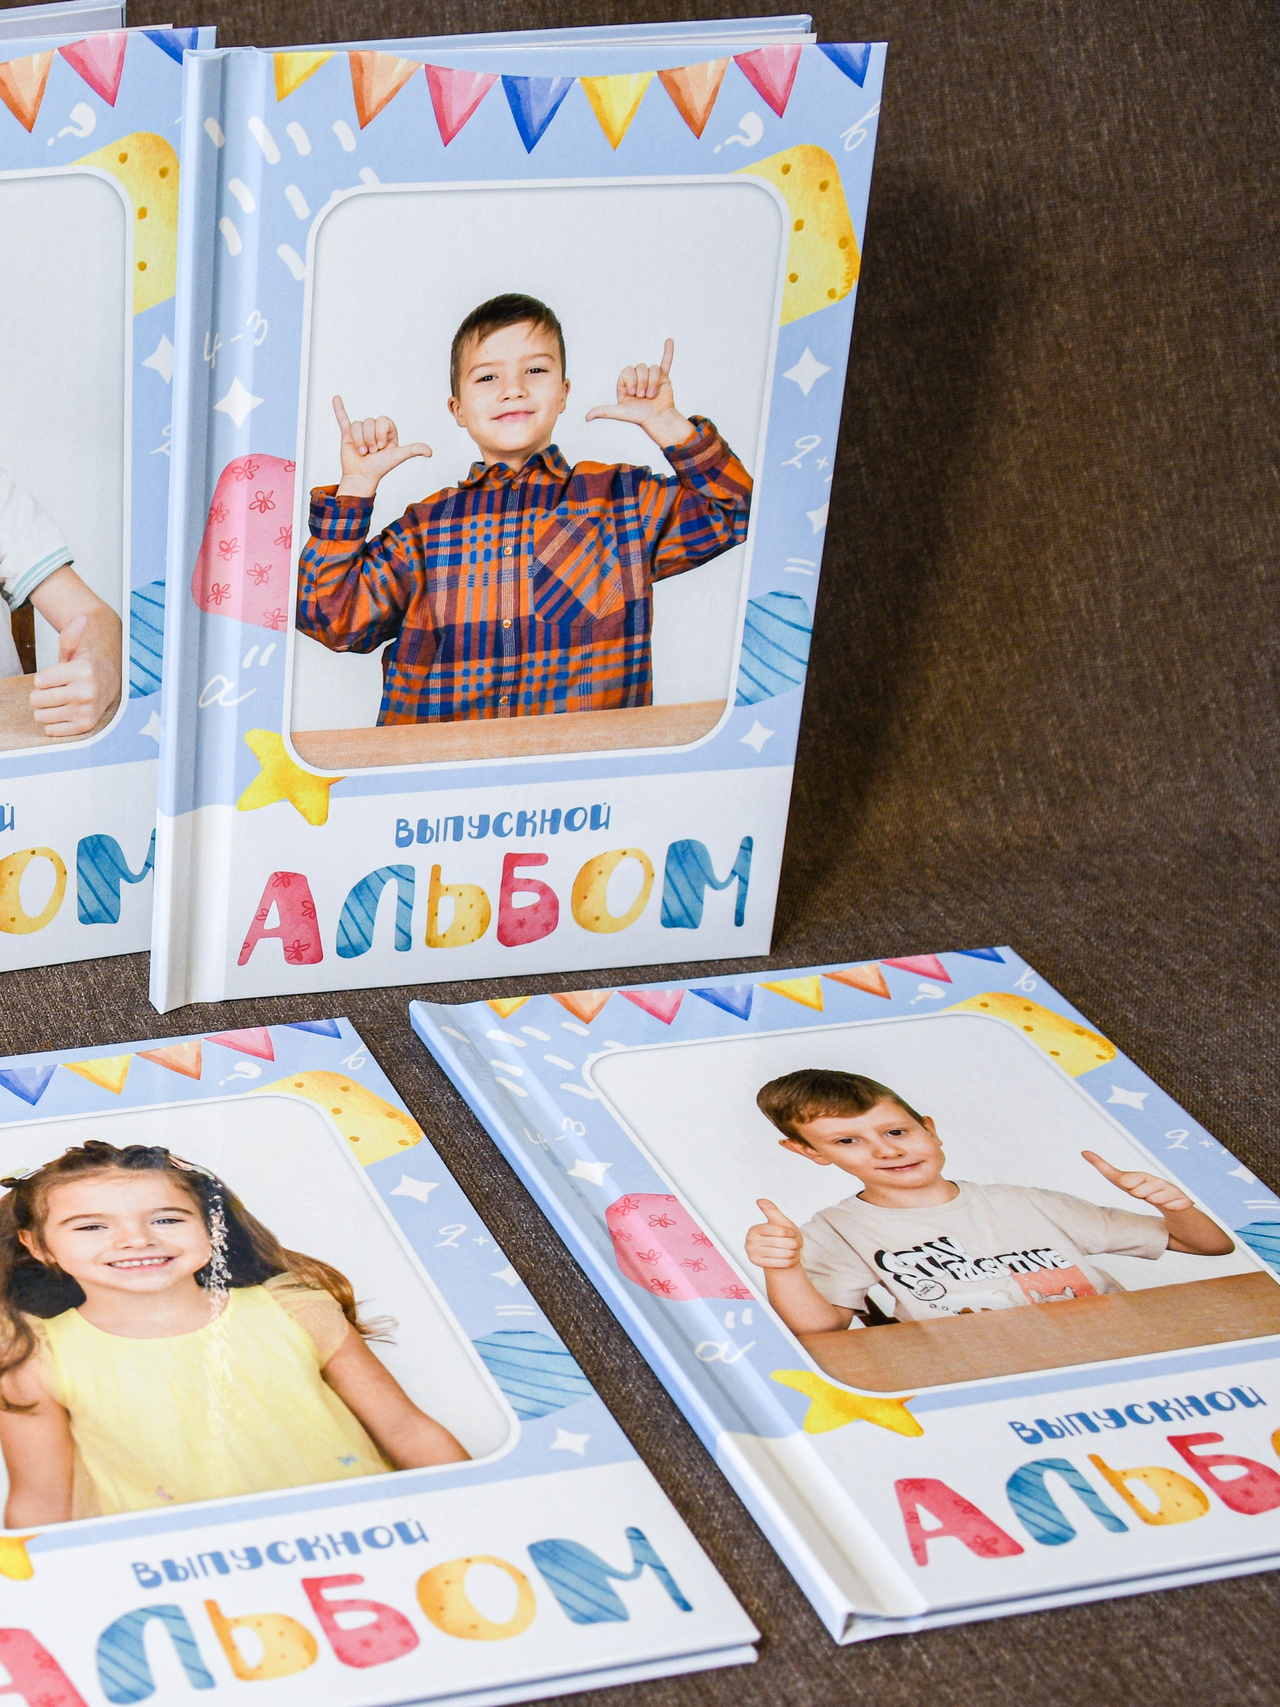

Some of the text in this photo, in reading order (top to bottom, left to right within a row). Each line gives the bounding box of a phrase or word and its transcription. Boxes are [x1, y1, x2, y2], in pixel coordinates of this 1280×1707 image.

[394, 800, 611, 848] ВЫПУСКНОЙ
[236, 835, 754, 967] АЛЬБОМ
[874, 1236, 976, 1291] STAY
[941, 1247, 1074, 1283] POSITIVE
[1007, 1384, 1267, 1445] ВЫПУСКНОЙ
[894, 1426, 1280, 1567] АЛЬБ
[131, 1516, 430, 1590] ВЫПУСКНОЙ
